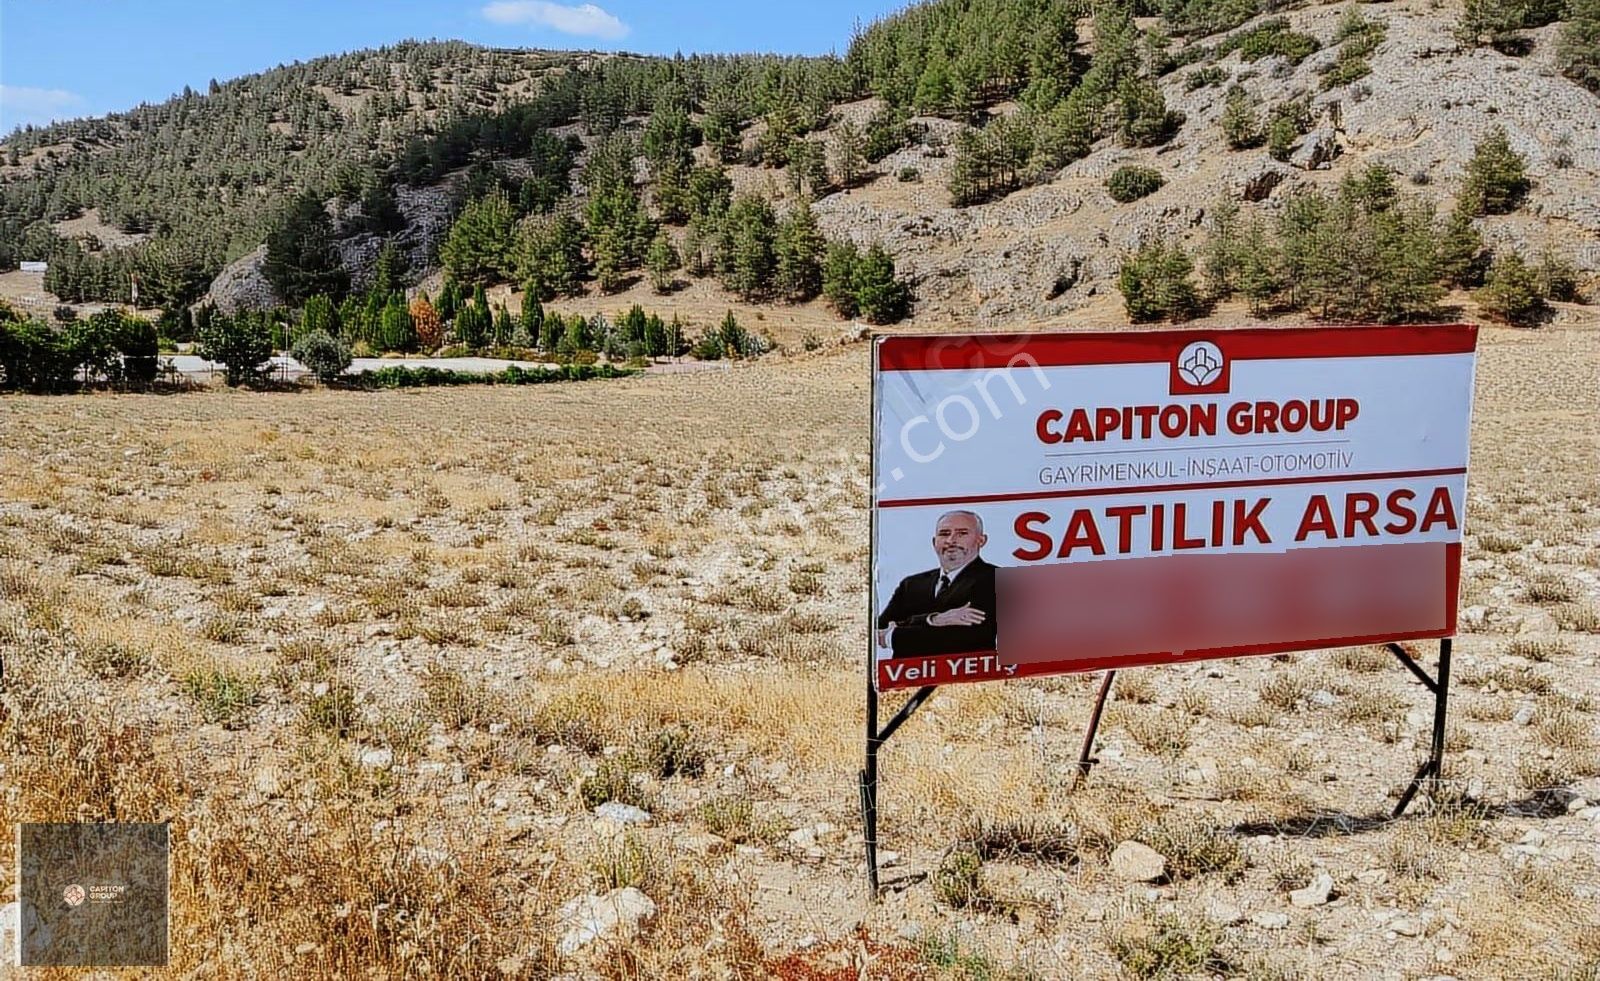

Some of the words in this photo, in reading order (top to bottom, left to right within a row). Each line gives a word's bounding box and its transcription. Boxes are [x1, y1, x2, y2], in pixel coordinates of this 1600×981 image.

[1036, 403, 1217, 444] CAPITON
[1226, 398, 1360, 435] GROUP
[1039, 449, 1354, 485] GAYRİMENKUL-İNŞAAT-OTOMOTİV
[1012, 497, 1272, 562] SATILIK
[1294, 486, 1458, 542] ARSA
[884, 660, 936, 682] Veli
